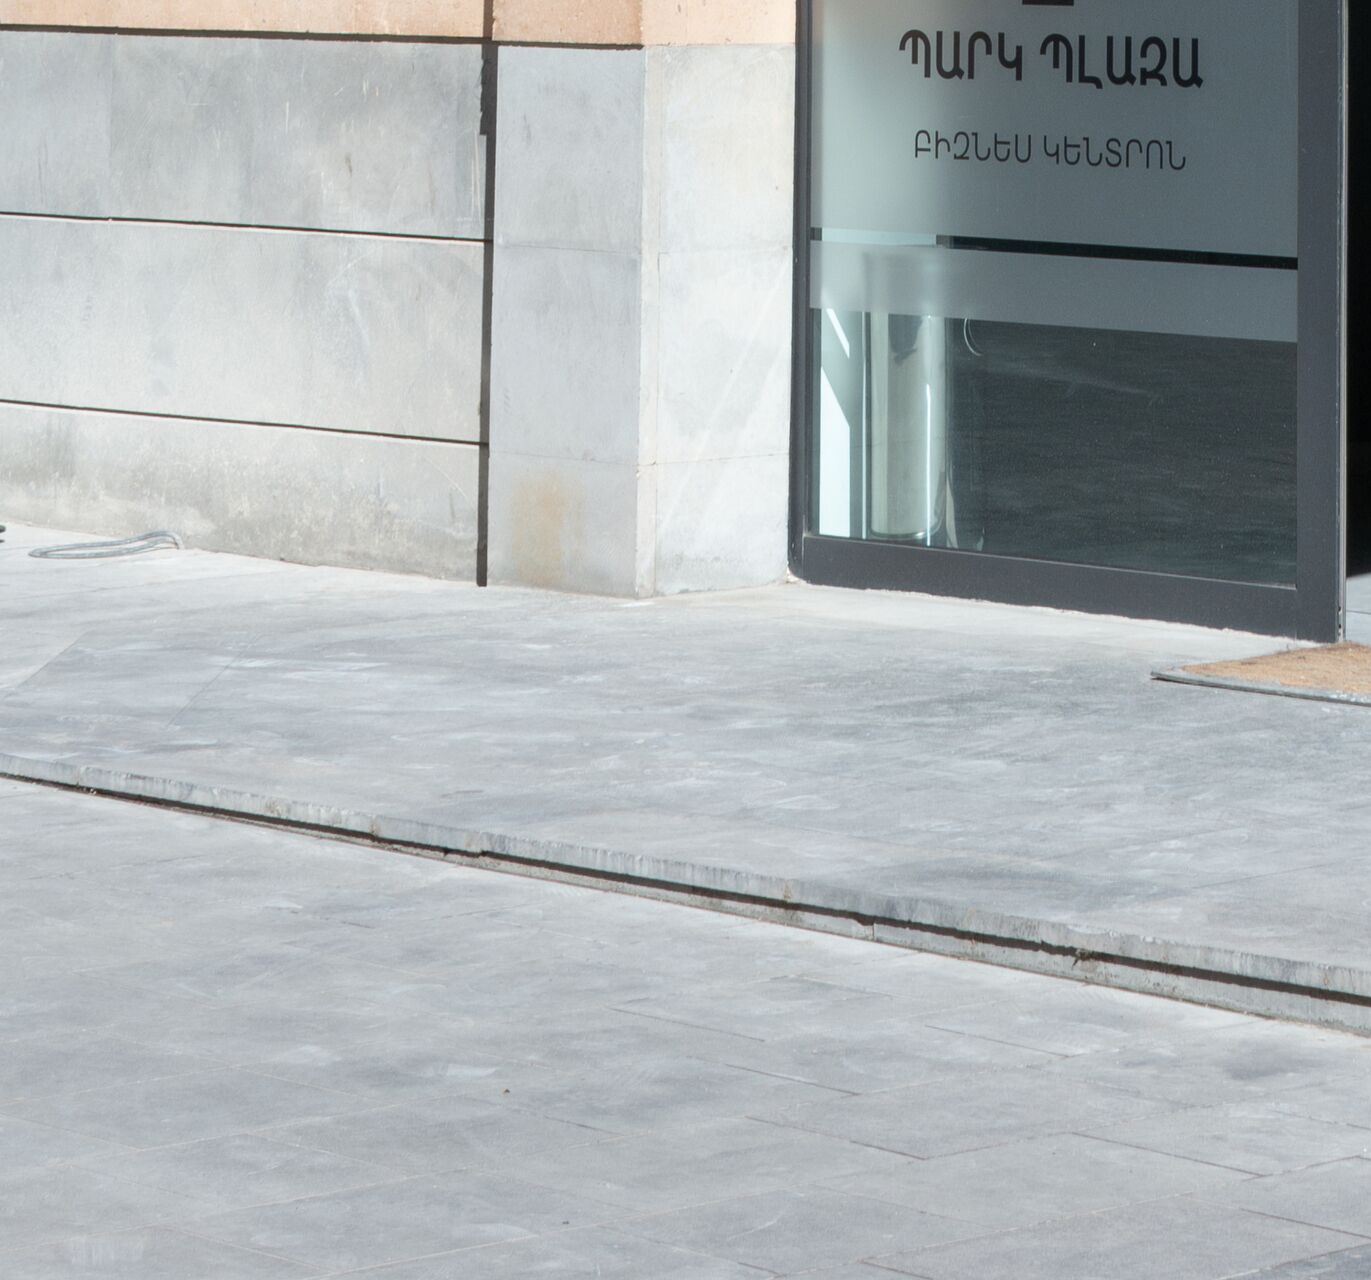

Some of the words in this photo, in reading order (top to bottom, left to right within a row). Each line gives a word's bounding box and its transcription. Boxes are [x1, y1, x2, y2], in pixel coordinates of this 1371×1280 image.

[898, 28, 1024, 82] ՊԱՐԿ
[1039, 32, 1205, 91] ՊԼԱԶԱ
[914, 129, 1033, 165] ԲԻԶՆԵՍ
[1042, 134, 1188, 172] ԿԵՆՏՐՈՆ
